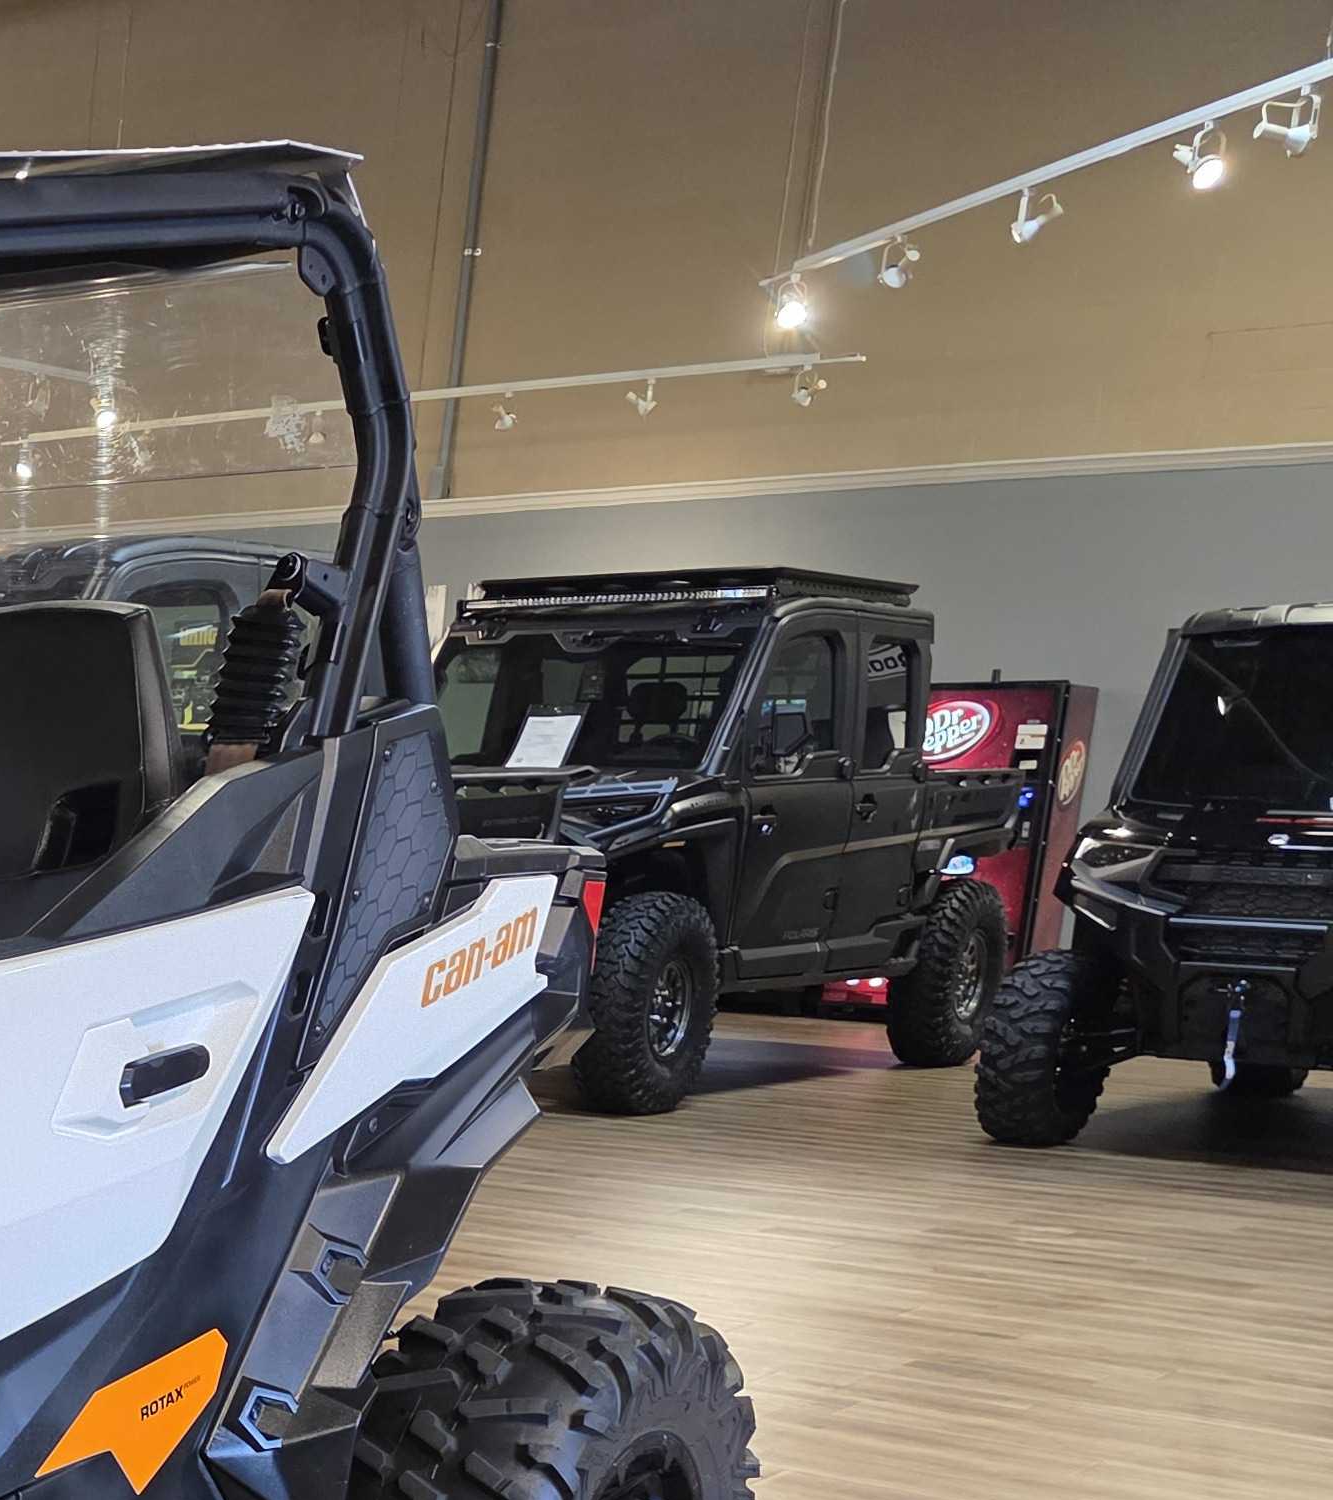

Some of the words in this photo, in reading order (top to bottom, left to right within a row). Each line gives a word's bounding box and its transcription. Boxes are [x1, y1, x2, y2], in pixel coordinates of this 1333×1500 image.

[933, 708, 964, 732] Dr
[420, 905, 538, 1008] can-am
[140, 1384, 184, 1421] ROTAX
